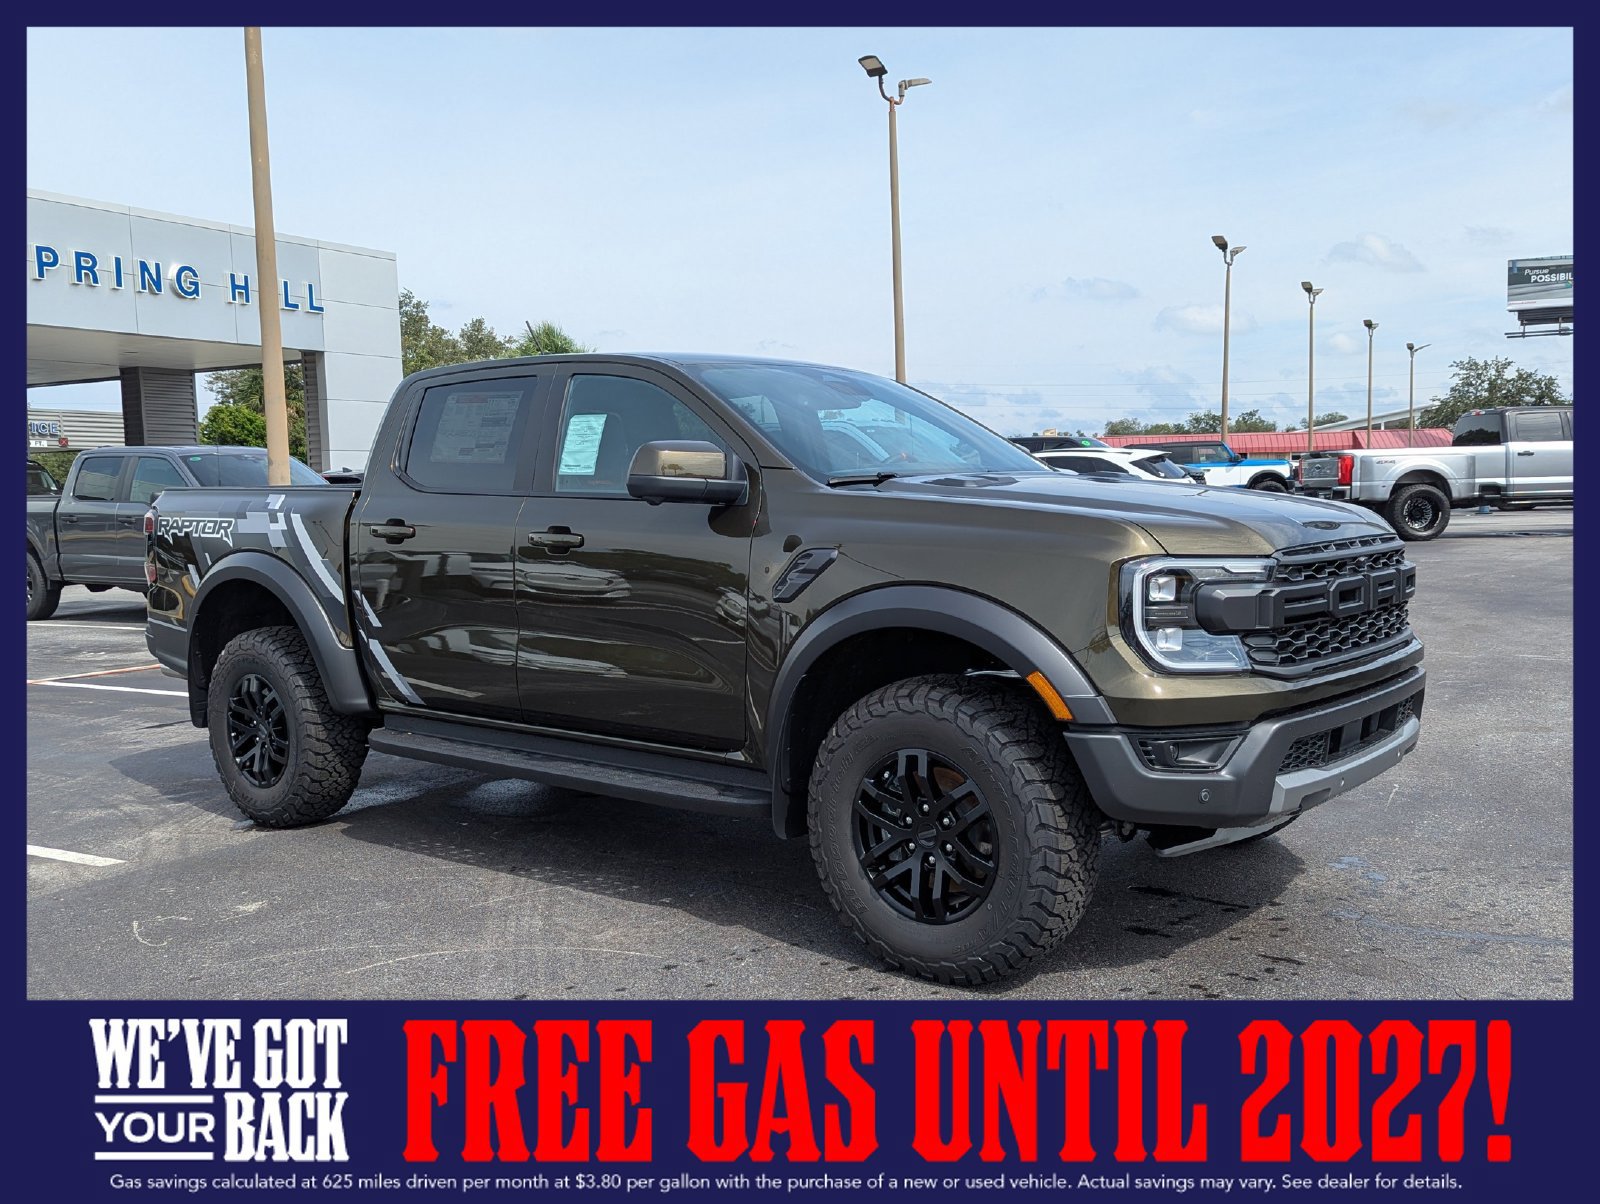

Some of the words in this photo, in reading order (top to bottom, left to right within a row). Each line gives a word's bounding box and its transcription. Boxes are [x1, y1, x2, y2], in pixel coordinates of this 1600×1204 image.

[34, 243, 201, 299] PRING
[228, 272, 325, 314] HLL
[1524, 268, 1550, 276] Pursue
[1530, 272, 1574, 283] POSSIBIL
[157, 516, 235, 547] RAPTOR
[1268, 561, 1417, 628] FORD
